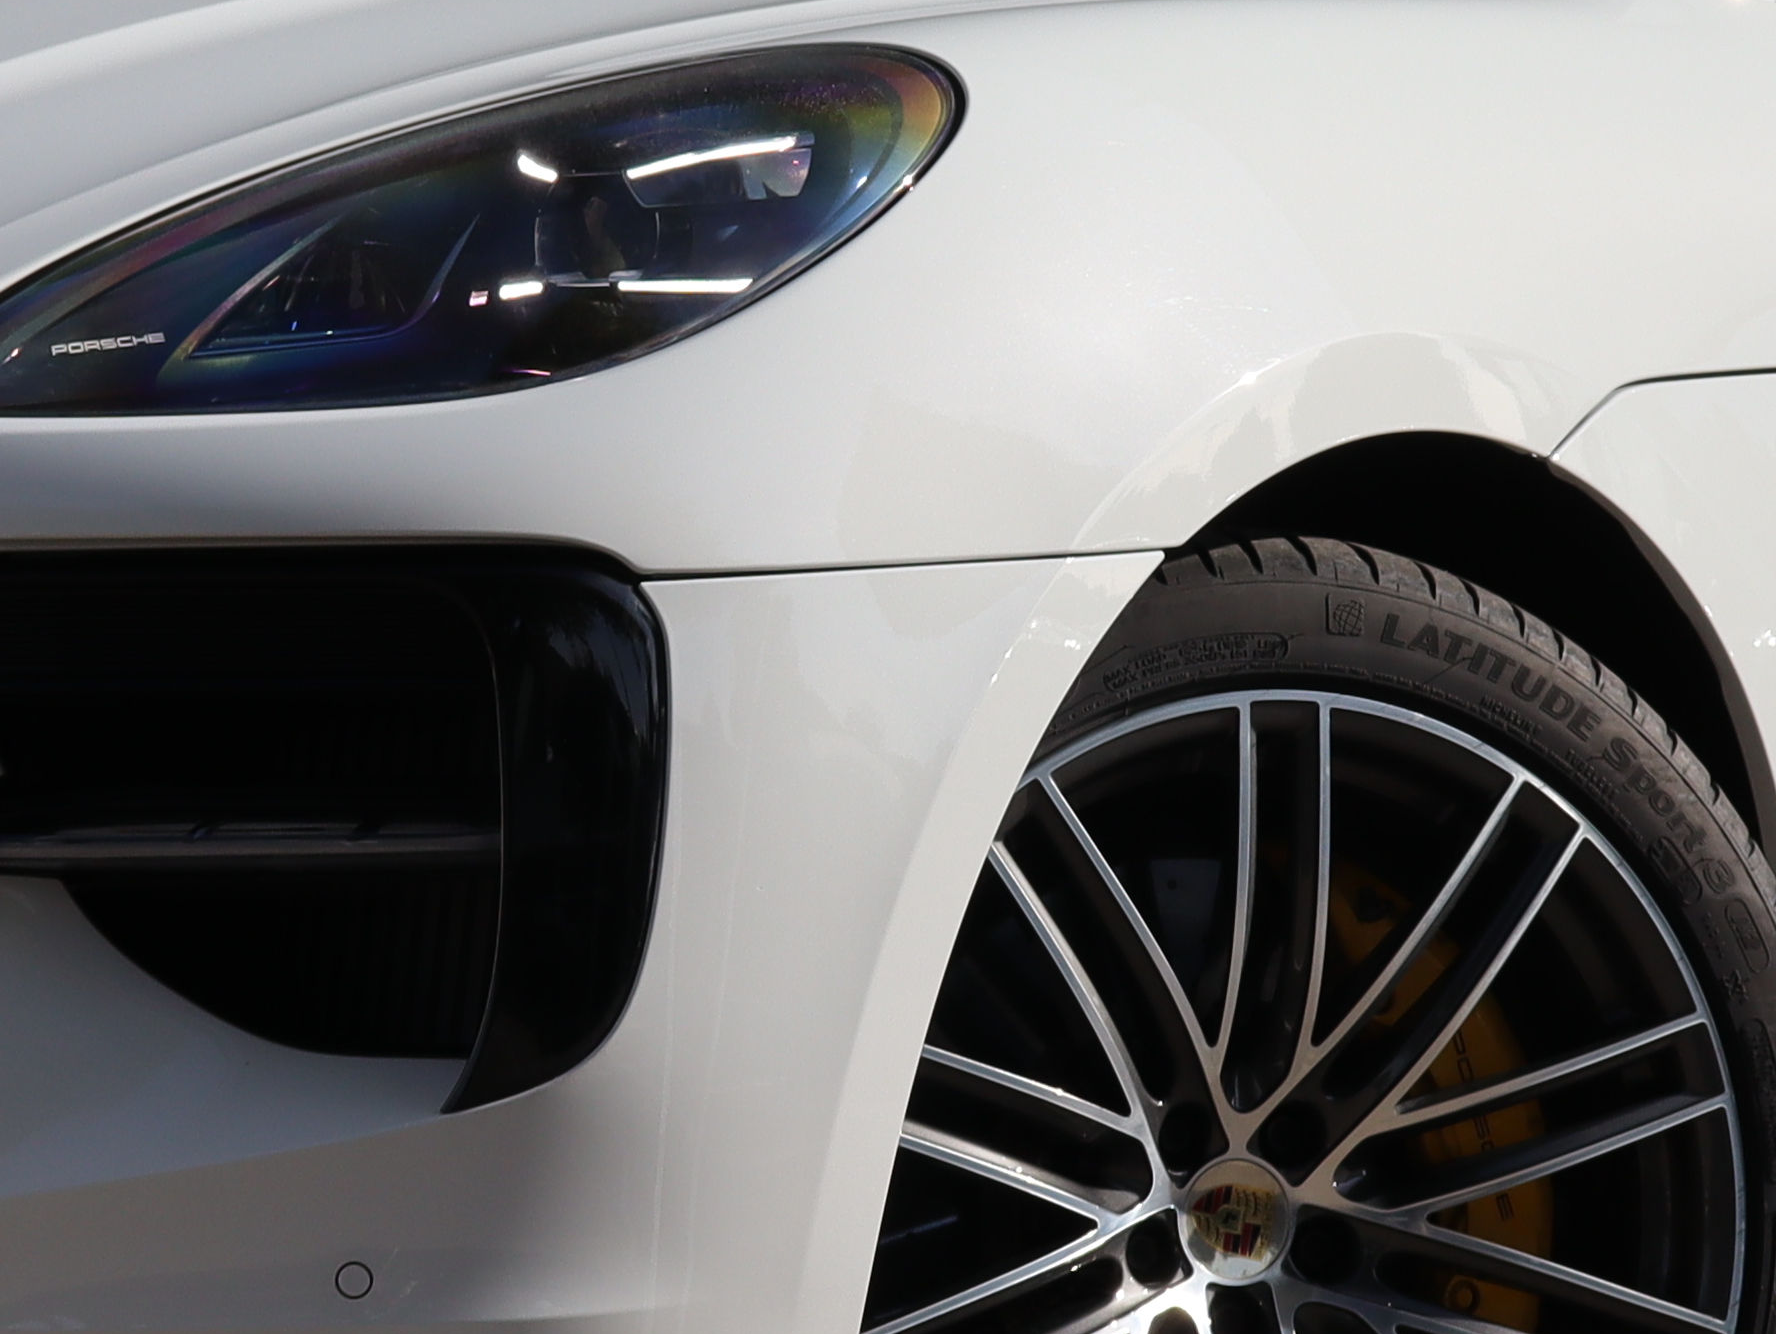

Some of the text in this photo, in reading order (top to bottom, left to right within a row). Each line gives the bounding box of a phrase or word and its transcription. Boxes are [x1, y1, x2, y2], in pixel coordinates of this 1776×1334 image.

[50, 331, 166, 357] PORSCHE
[1380, 612, 1602, 742] LATITUDE
[1602, 737, 1708, 856] Sport
